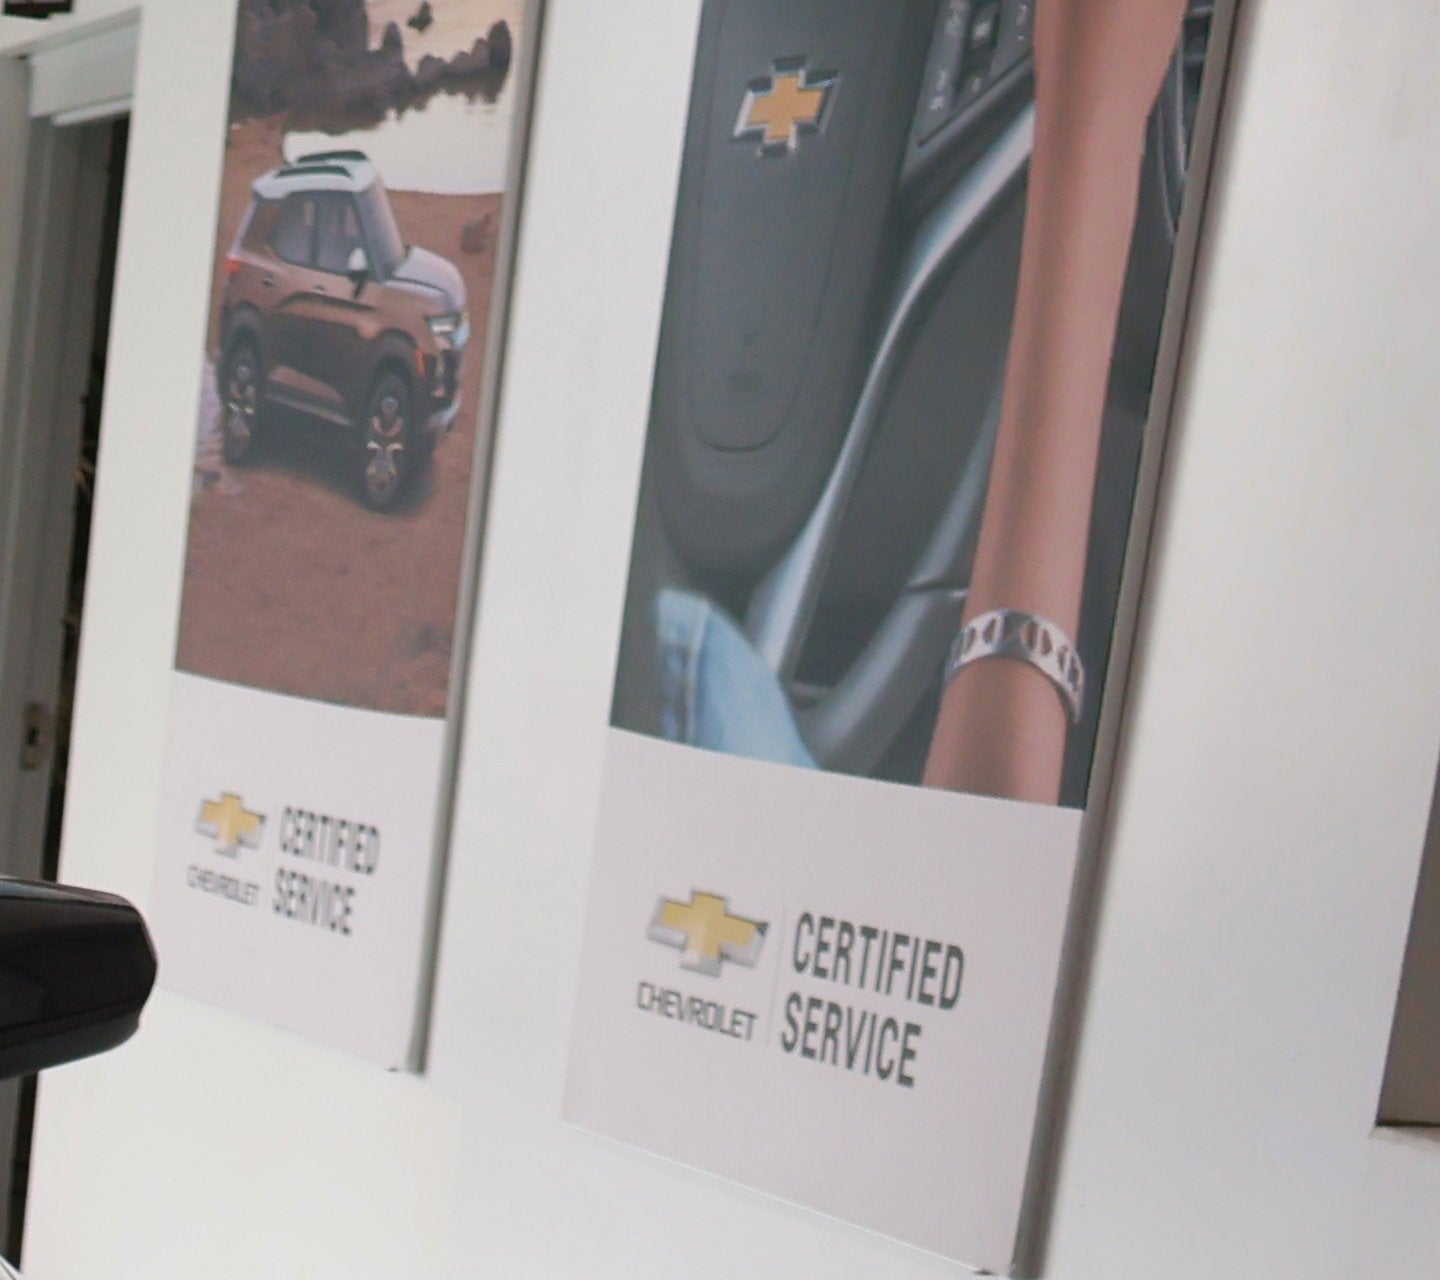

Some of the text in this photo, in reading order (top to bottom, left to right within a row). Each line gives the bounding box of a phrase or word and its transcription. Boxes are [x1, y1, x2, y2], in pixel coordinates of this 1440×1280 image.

[279, 806, 381, 877] CERTIFIED
[272, 868, 356, 936] SERVICE
[792, 911, 966, 1011] CERTIFIED
[636, 981, 758, 1042] CHEVROLET
[781, 991, 923, 1088] SERVICE
